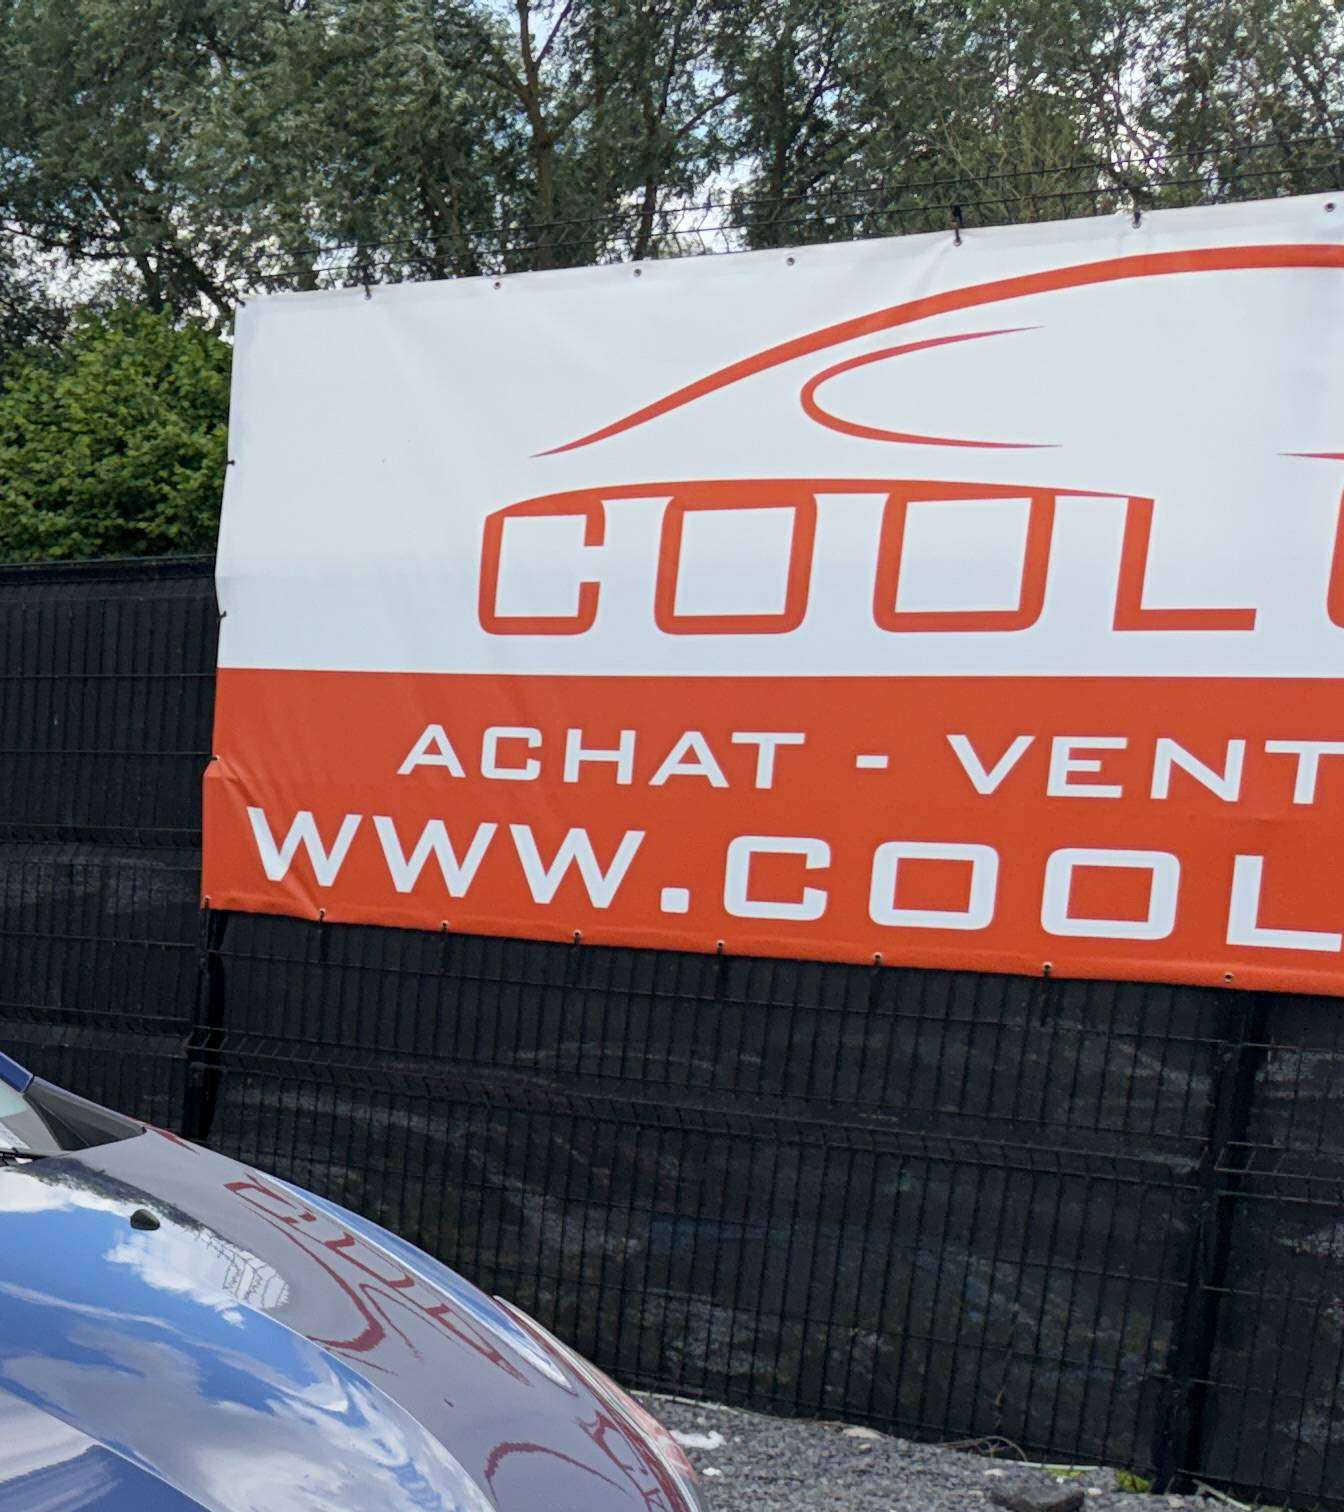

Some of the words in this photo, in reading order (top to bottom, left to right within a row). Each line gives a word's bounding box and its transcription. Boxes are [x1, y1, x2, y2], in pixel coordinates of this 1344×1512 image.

[478, 478, 1344, 636] COOL
[397, 724, 806, 789] ACHAT
[946, 734, 1344, 805] VENT
[247, 806, 1343, 952] WWW.COOL
